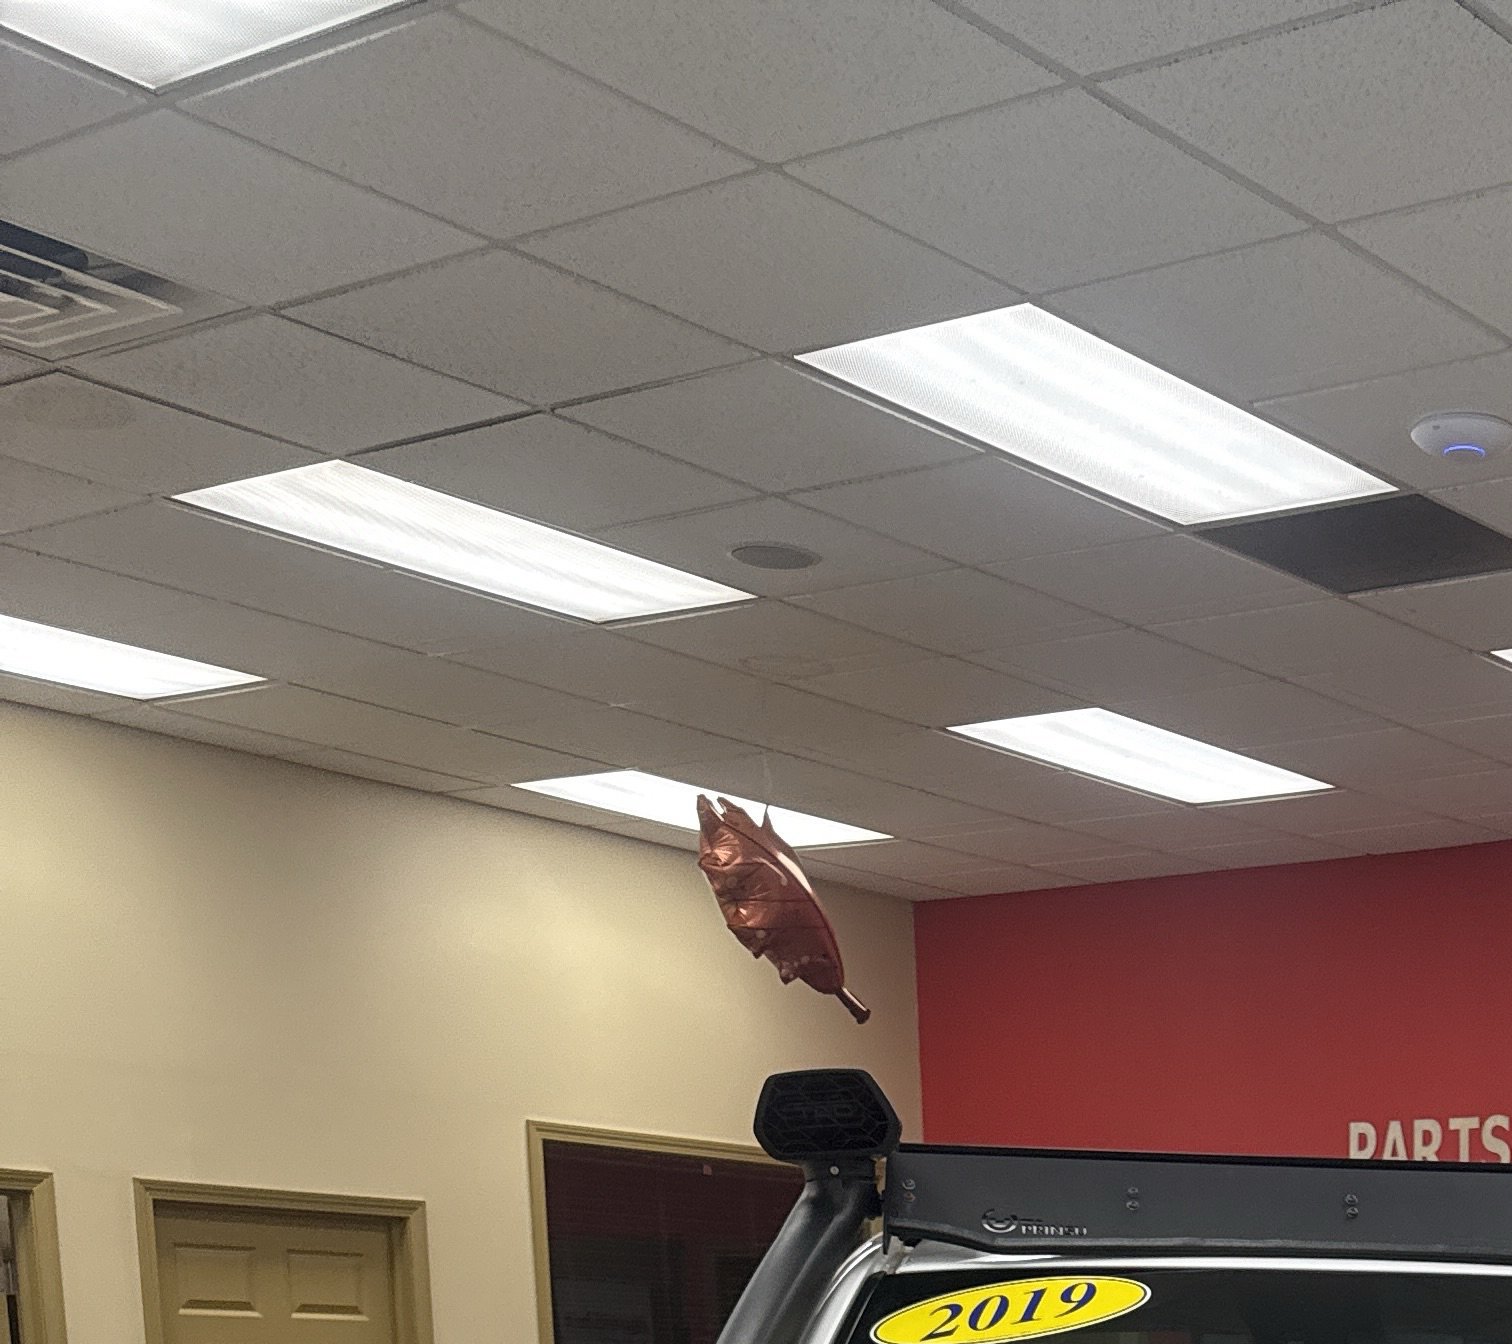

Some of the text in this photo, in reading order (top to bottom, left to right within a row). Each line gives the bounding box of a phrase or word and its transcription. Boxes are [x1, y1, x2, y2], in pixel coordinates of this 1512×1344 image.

[1347, 1114, 1511, 1164] PARTS
[1021, 1224, 1088, 1236] PRINSU
[920, 1282, 1097, 1342] 2019
